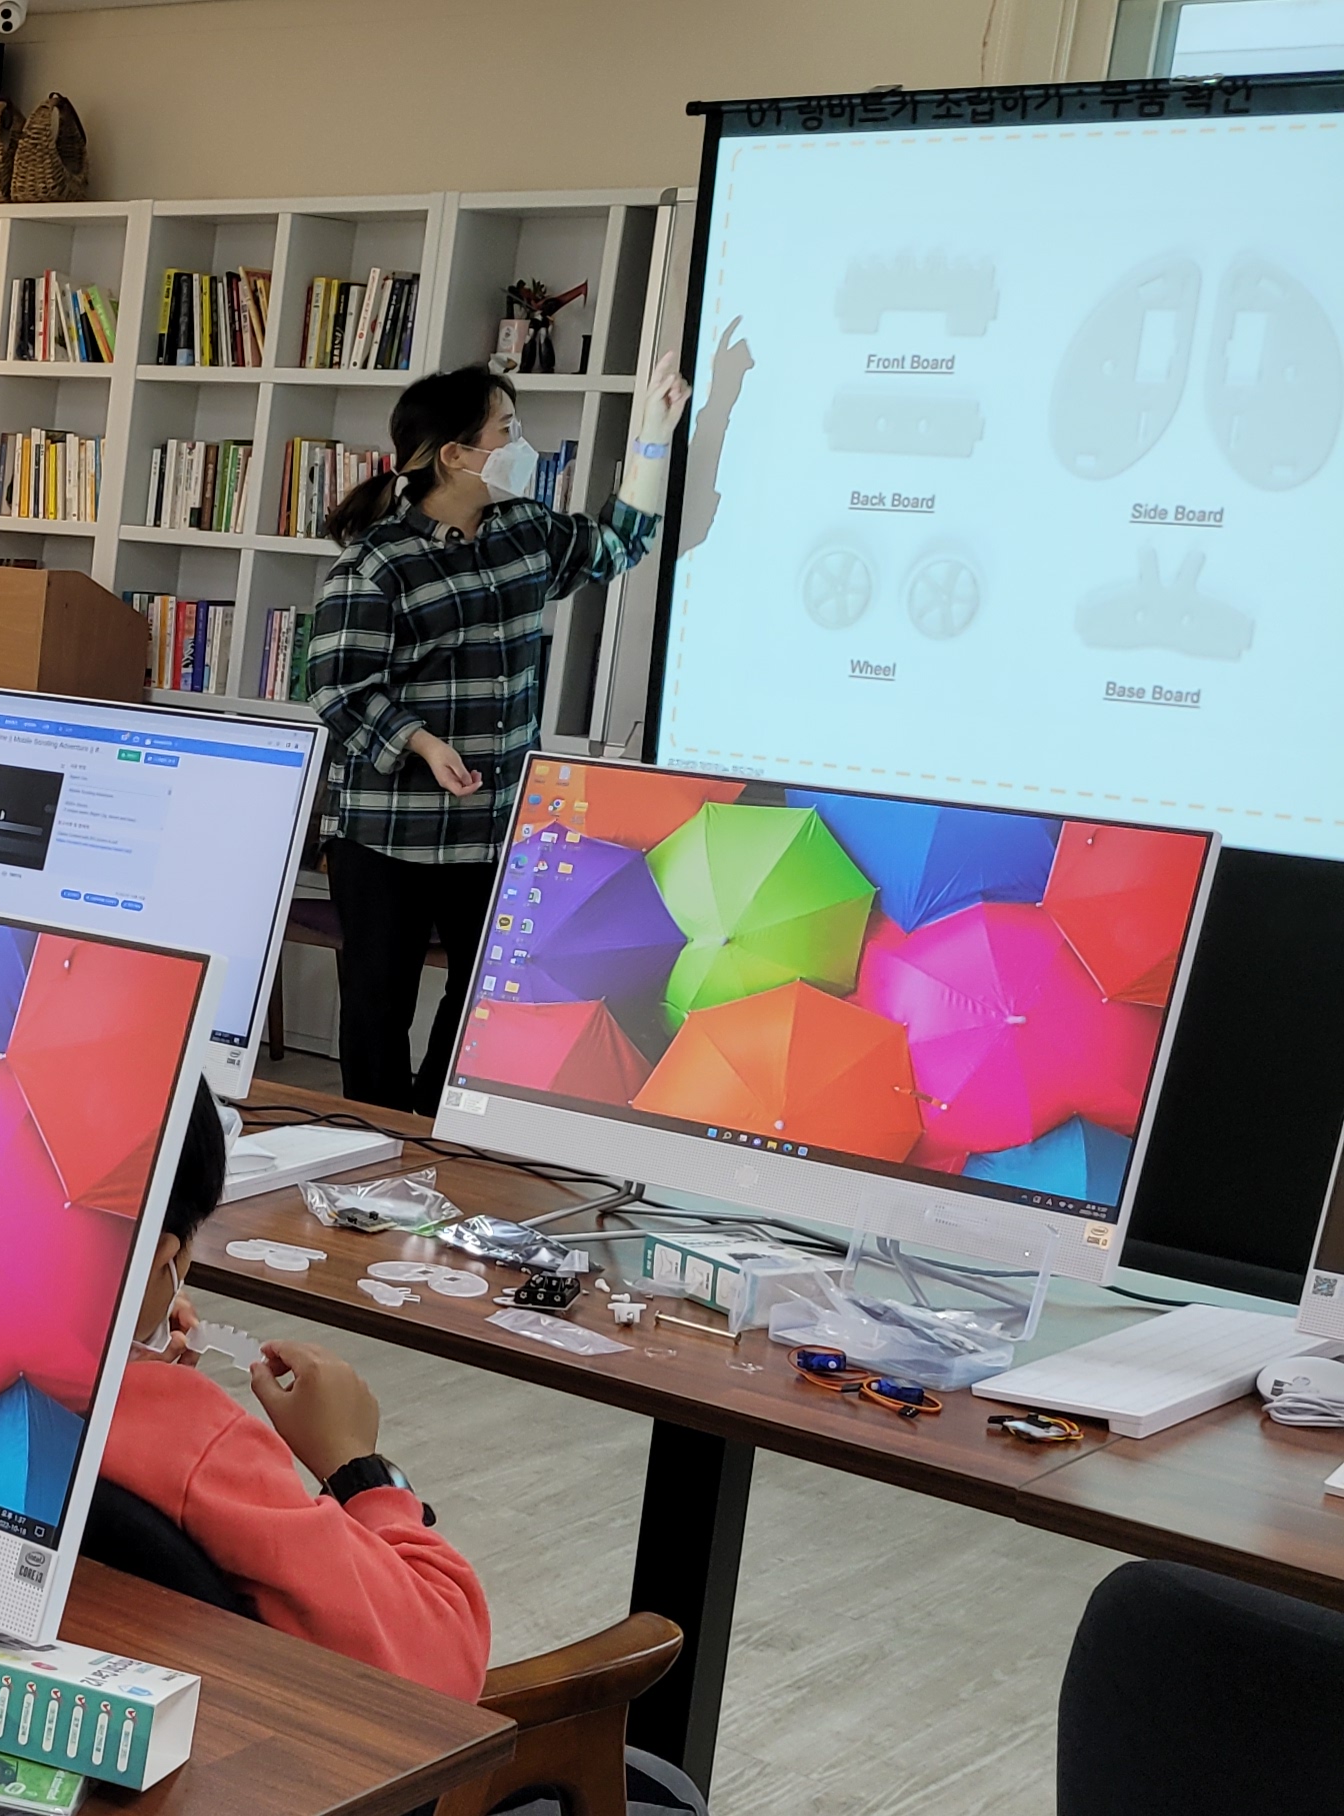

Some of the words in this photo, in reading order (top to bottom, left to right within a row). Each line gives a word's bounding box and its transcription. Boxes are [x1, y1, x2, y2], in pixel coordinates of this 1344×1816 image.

[866, 354, 907, 371] Front
[910, 354, 955, 371] Board
[850, 491, 886, 508] Back
[890, 492, 935, 510] Board
[1131, 503, 1170, 521] Side
[1173, 505, 1224, 524] Board
[850, 660, 896, 678] Wheel
[1105, 681, 1146, 701] Base
[1152, 684, 1201, 704] Board
[18, 1564, 37, 1583] CORE
